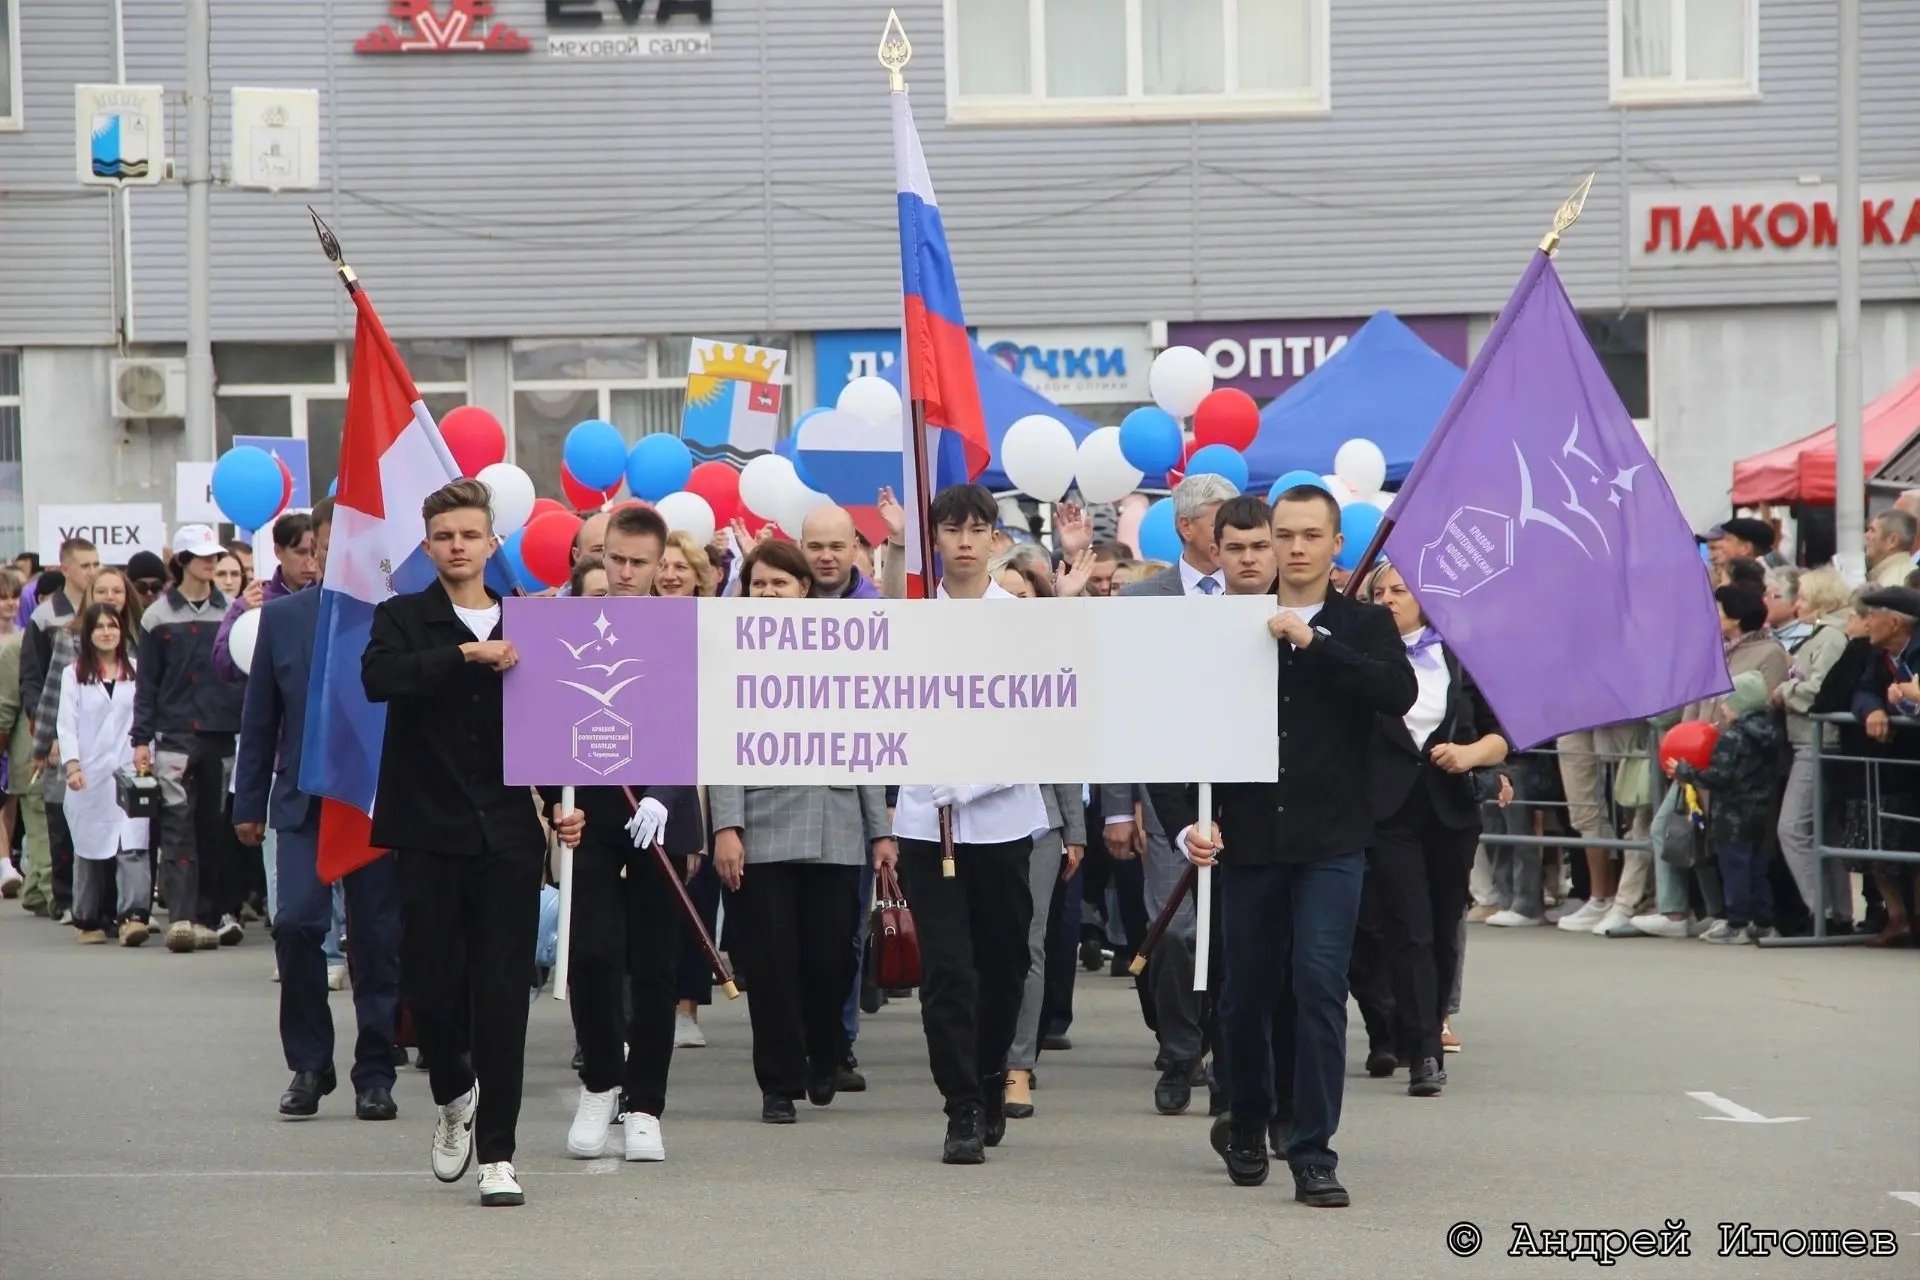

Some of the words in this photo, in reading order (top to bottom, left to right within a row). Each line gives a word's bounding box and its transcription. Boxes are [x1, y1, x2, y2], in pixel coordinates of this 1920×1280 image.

[550, 37, 639, 55] меховой
[649, 38, 709, 54] салон
[59, 525, 141, 545] УСПЕХ
[1448, 522, 1495, 576] ПОЛИТЕХНИЧЕСКИЙ
[1468, 525, 1495, 553] КРАЕВОЙ
[1445, 543, 1471, 571] КОЛЛЕДЖ
[736, 611, 889, 651] КРАЕВОЙ
[736, 667, 1077, 709] ПОЛИТЕХНИЧЕСКИЙ
[736, 732, 908, 772] КОЛЛЕДЖ
